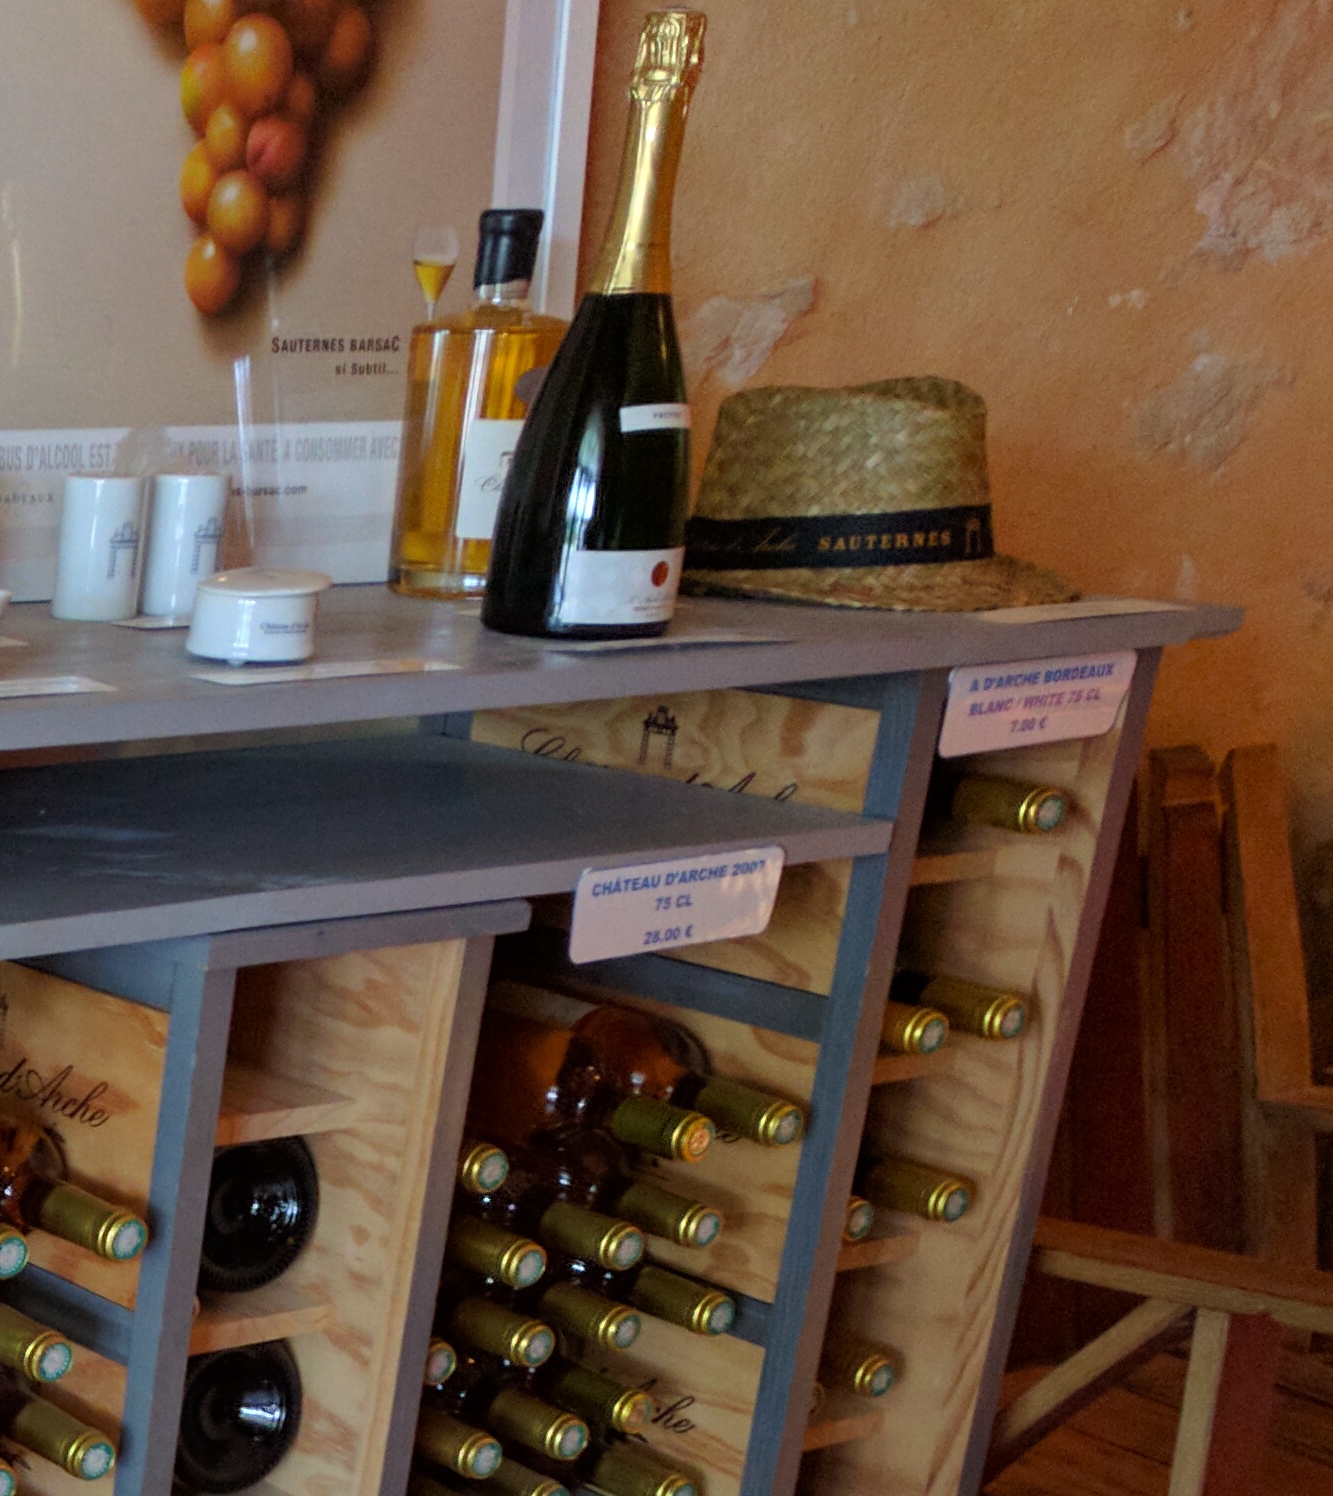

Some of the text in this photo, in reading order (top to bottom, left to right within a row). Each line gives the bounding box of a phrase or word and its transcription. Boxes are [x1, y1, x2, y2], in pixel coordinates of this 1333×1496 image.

[272, 335, 401, 354] SAUTERNES BARSAC
[26, 443, 83, 471] D'ALCOOL
[89, 442, 112, 469] EST
[818, 529, 952, 551] SAUTERNES
[969, 662, 1116, 692] A D'ARCHE BORDEAUX
[968, 698, 1013, 717] BLANC
[1023, 691, 1065, 709] WHITE
[591, 873, 661, 898] CHÂTEAU
[665, 864, 729, 886] D'ARCHE
[655, 893, 693, 911] 75 CL
[643, 924, 694, 946] 28.00 €
